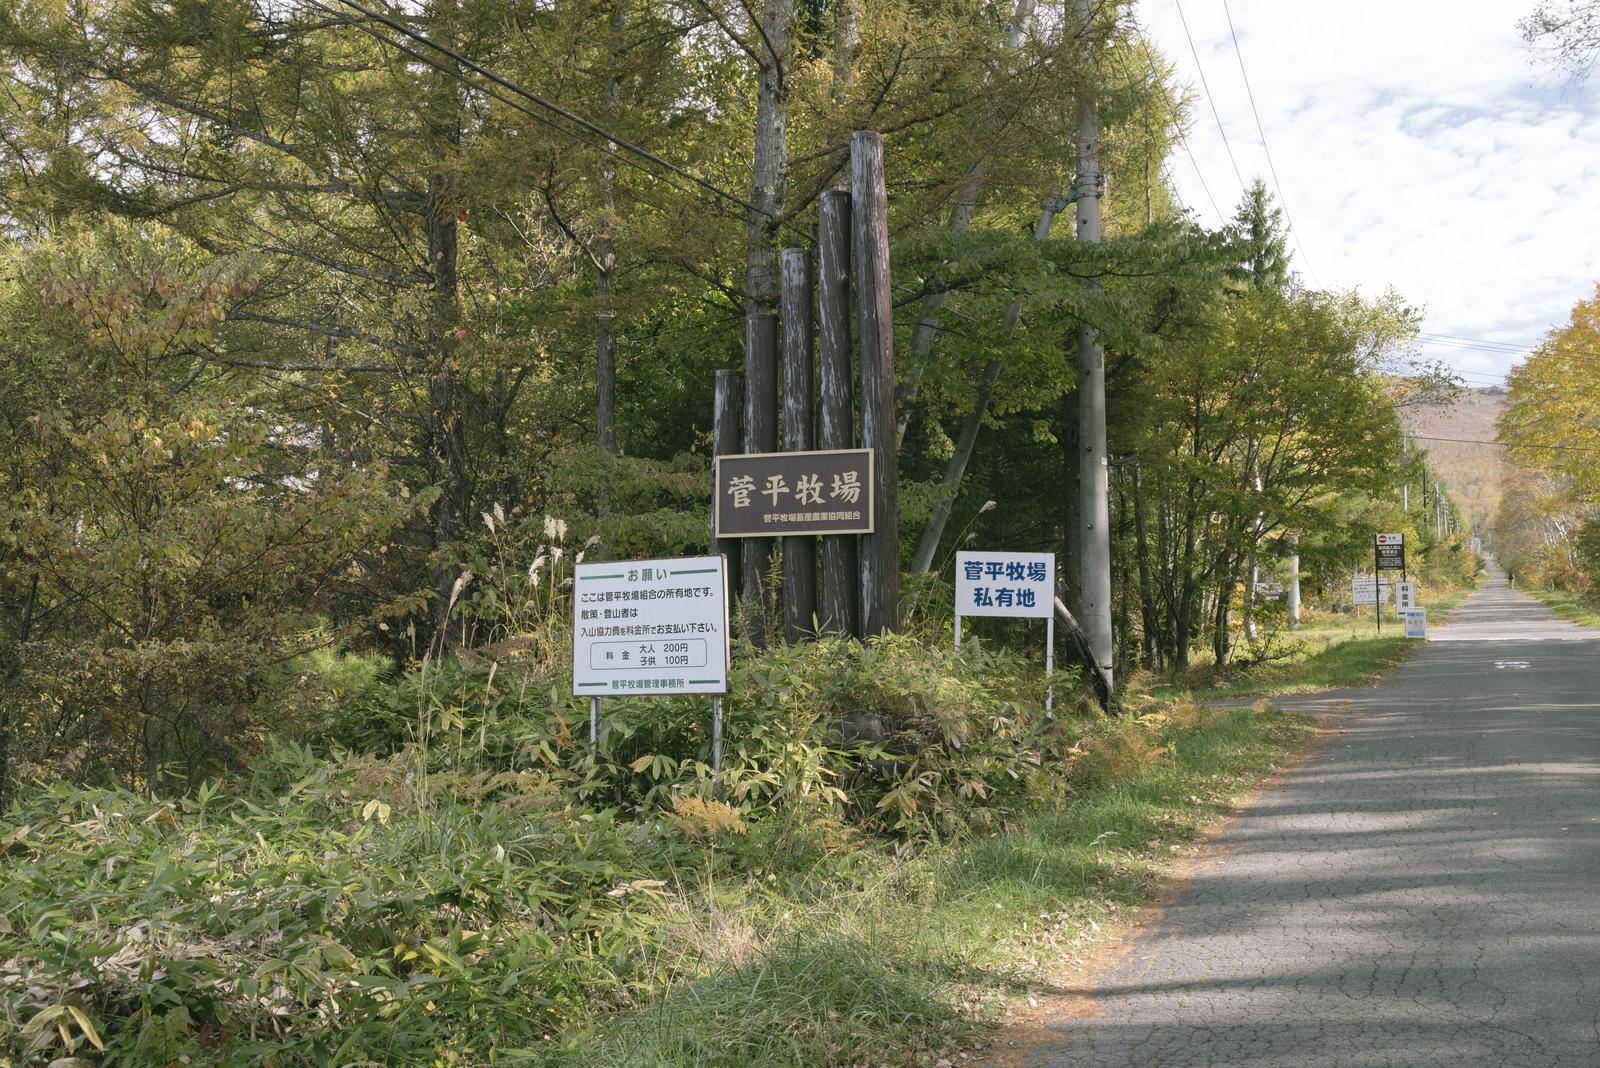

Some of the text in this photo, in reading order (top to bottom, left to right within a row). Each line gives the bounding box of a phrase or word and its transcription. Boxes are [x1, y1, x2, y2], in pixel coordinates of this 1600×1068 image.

[727, 470, 862, 509] 菅平牧場
[628, 568, 668, 582] お願い
[964, 560, 1047, 582] 菅平牧場
[581, 587, 714, 603] ここは菅平牧場組合の所有地です。
[973, 587, 1036, 608] 私有地
[1401, 585, 1409, 608] 料金所
[581, 608, 638, 620] 散策・登山者は
[581, 622, 718, 638] 入山協力費を料金所でお支払い下さい。
[639, 643, 689, 654] 大人 200円
[640, 656, 689, 666] 子供 100円
[611, 678, 685, 690] 菅平牧場管理事務所
